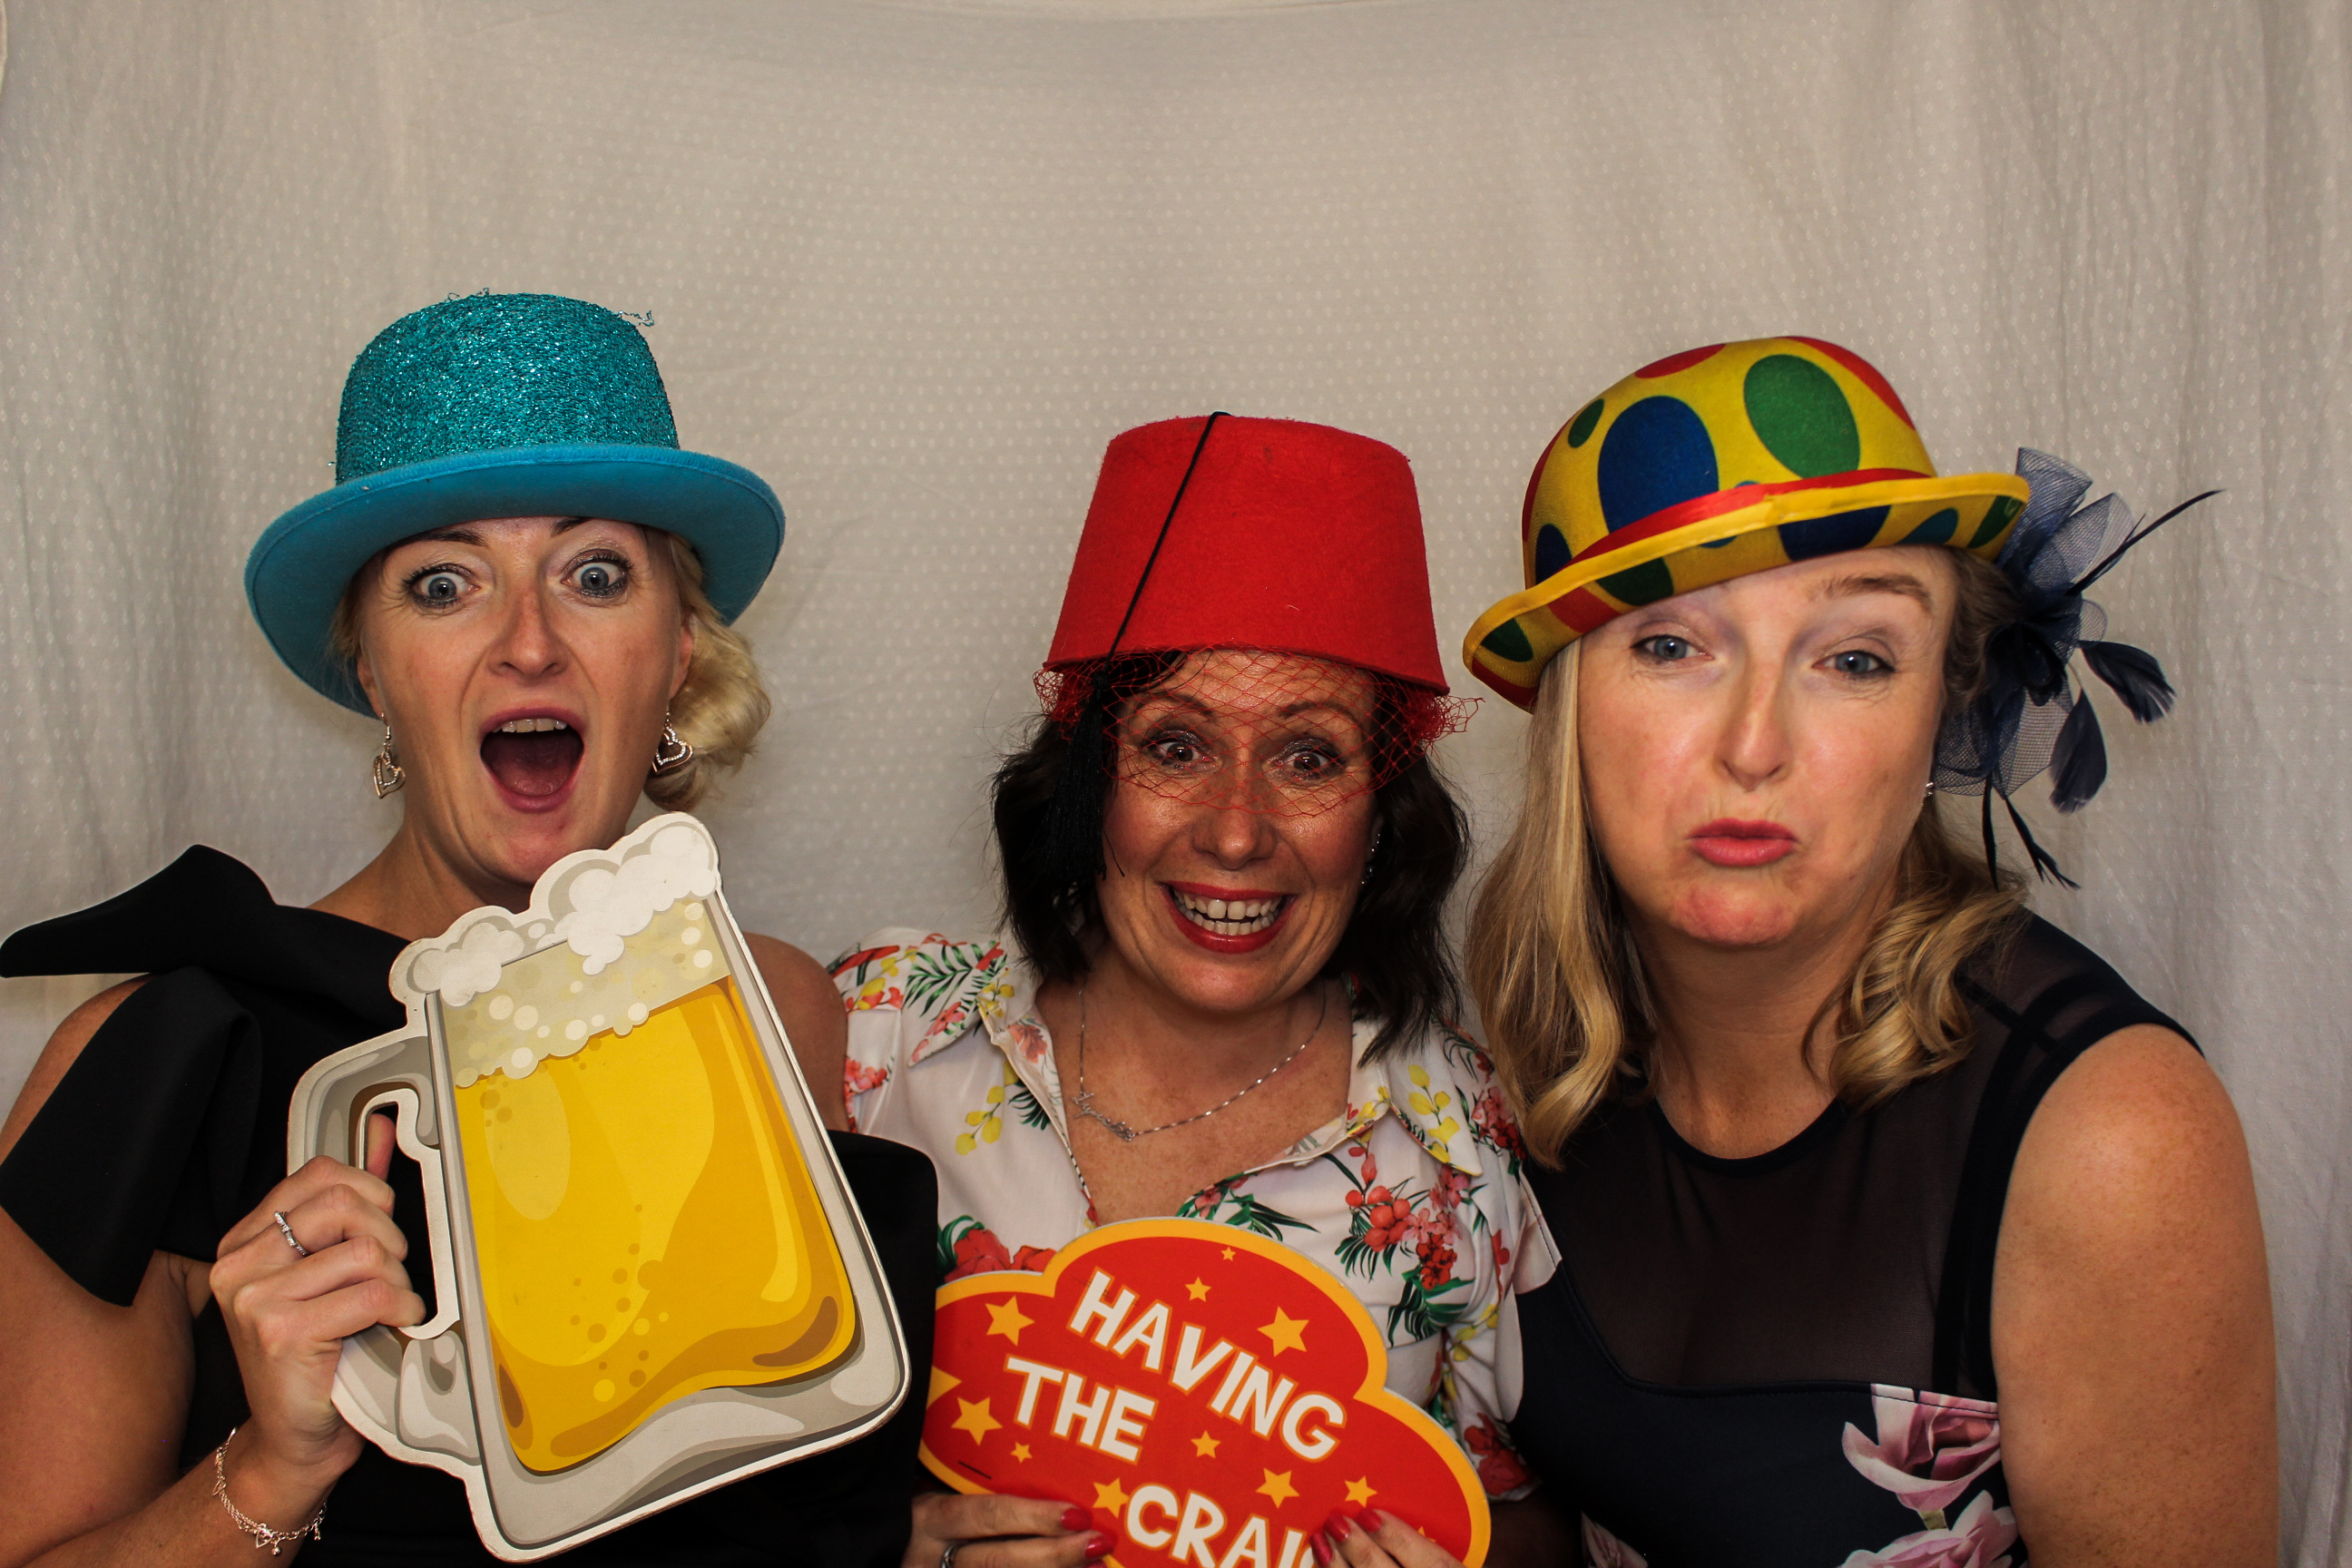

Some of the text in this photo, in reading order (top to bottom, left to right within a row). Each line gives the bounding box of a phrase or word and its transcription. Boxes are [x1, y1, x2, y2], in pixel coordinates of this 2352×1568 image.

[1007, 1357, 1156, 1461] THE
[1071, 1270, 1345, 1460] HAVING
[1127, 1485, 1315, 1568] CRAI
